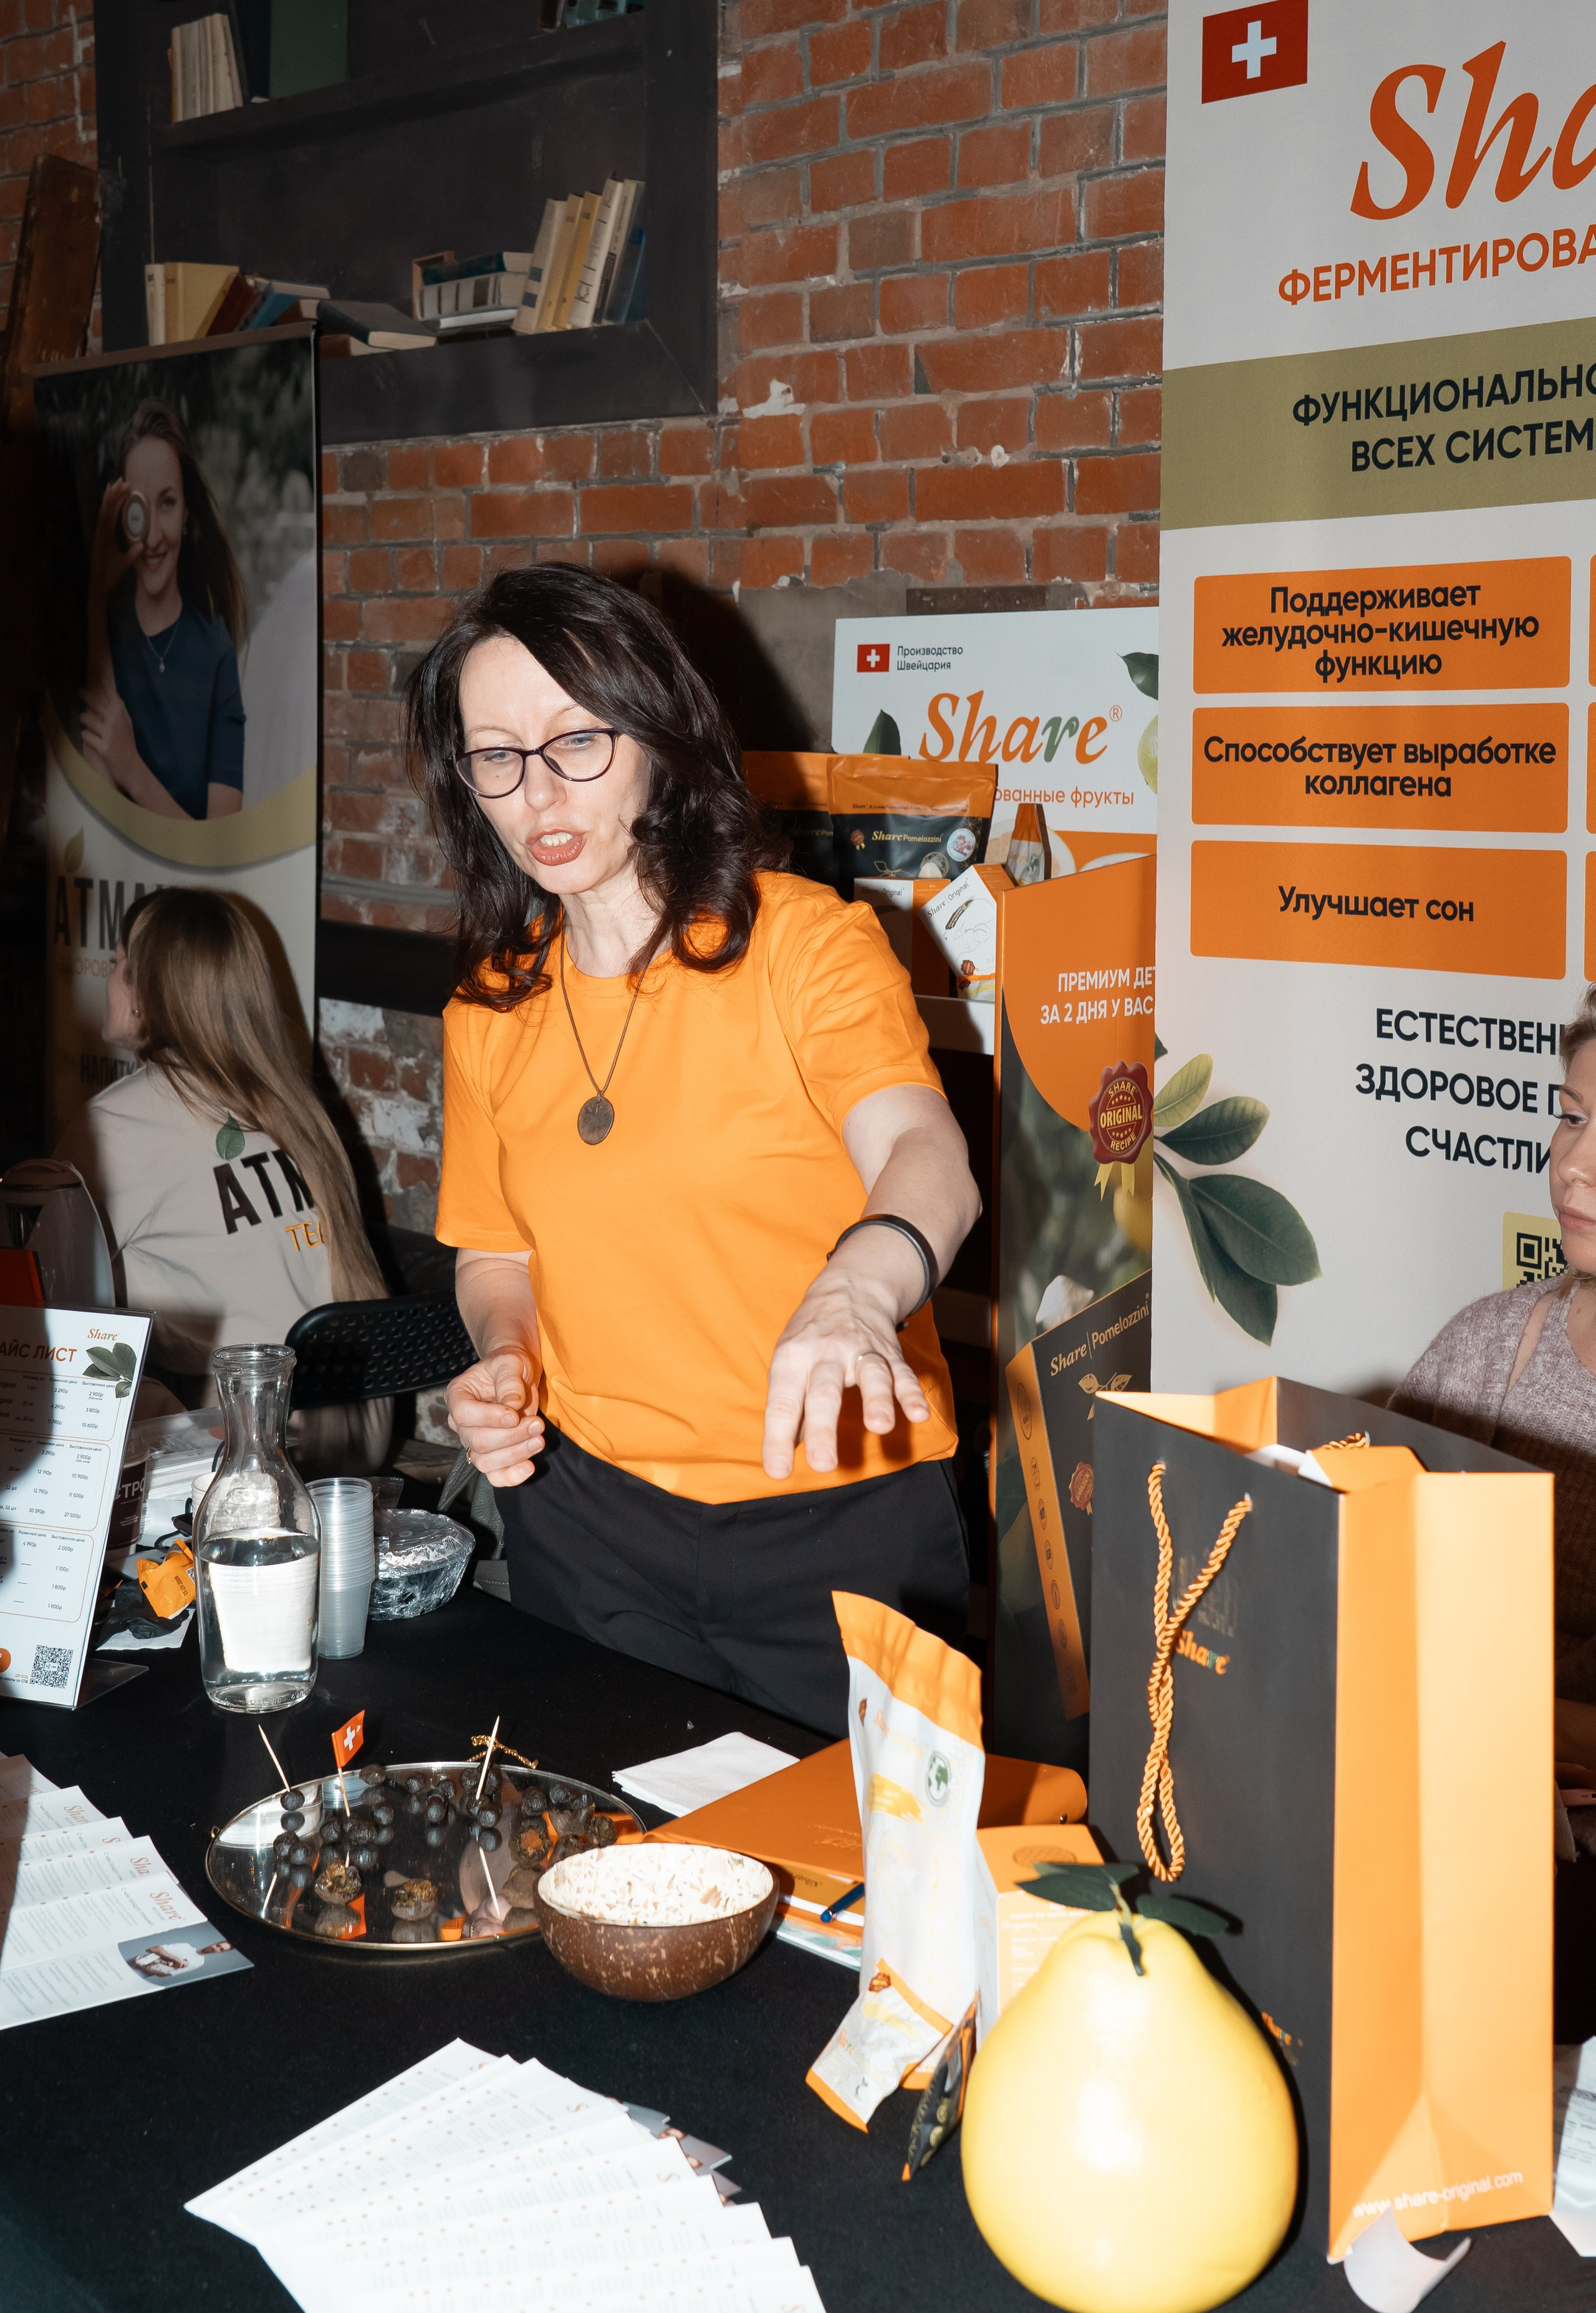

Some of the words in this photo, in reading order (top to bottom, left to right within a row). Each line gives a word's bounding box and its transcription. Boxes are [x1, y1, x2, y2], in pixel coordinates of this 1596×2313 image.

[1352, 434, 1435, 473] ВСЕХ
[1446, 420, 1594, 464] СИСТЕМ
[1270, 584, 1481, 617] Поддерживает
[1221, 616, 1539, 652] желудочно-кишечную
[897, 645, 963, 658] Производство
[897, 659, 951, 673] Швейцария
[1315, 649, 1442, 683] функцию
[1203, 736, 1396, 771] Способствует
[1403, 735, 1556, 771] выработке
[1070, 786, 1135, 809] фрукты
[1304, 774, 1452, 797] коллагена
[872, 830, 903, 842] Share
[948, 881, 969, 902] Original
[1277, 885, 1419, 921] Улучшает
[1425, 900, 1474, 922] сон
[1058, 968, 1130, 993] ПРЕМИУМ
[1040, 1004, 1060, 1024] ЗА
[1064, 1002, 1074, 1022] 2
[1075, 999, 1108, 1024] ДНЯ
[1111, 998, 1122, 1018] У
[1124, 995, 1154, 1017] ВАС
[1108, 1080, 1137, 1097] SHARE
[1355, 1063, 1538, 1113] ЗДОРОВОЕ
[1100, 1104, 1143, 1129] ORIGINAL
[1110, 1132, 1137, 1152] RECIPE
[87, 1328, 118, 1341] Share
[1050, 1343, 1087, 1377] Share
[1091, 1301, 1150, 1350] Pomelozzini
[32, 1345, 78, 1363] ЛИСТ
[150, 1891, 182, 1921] Share
